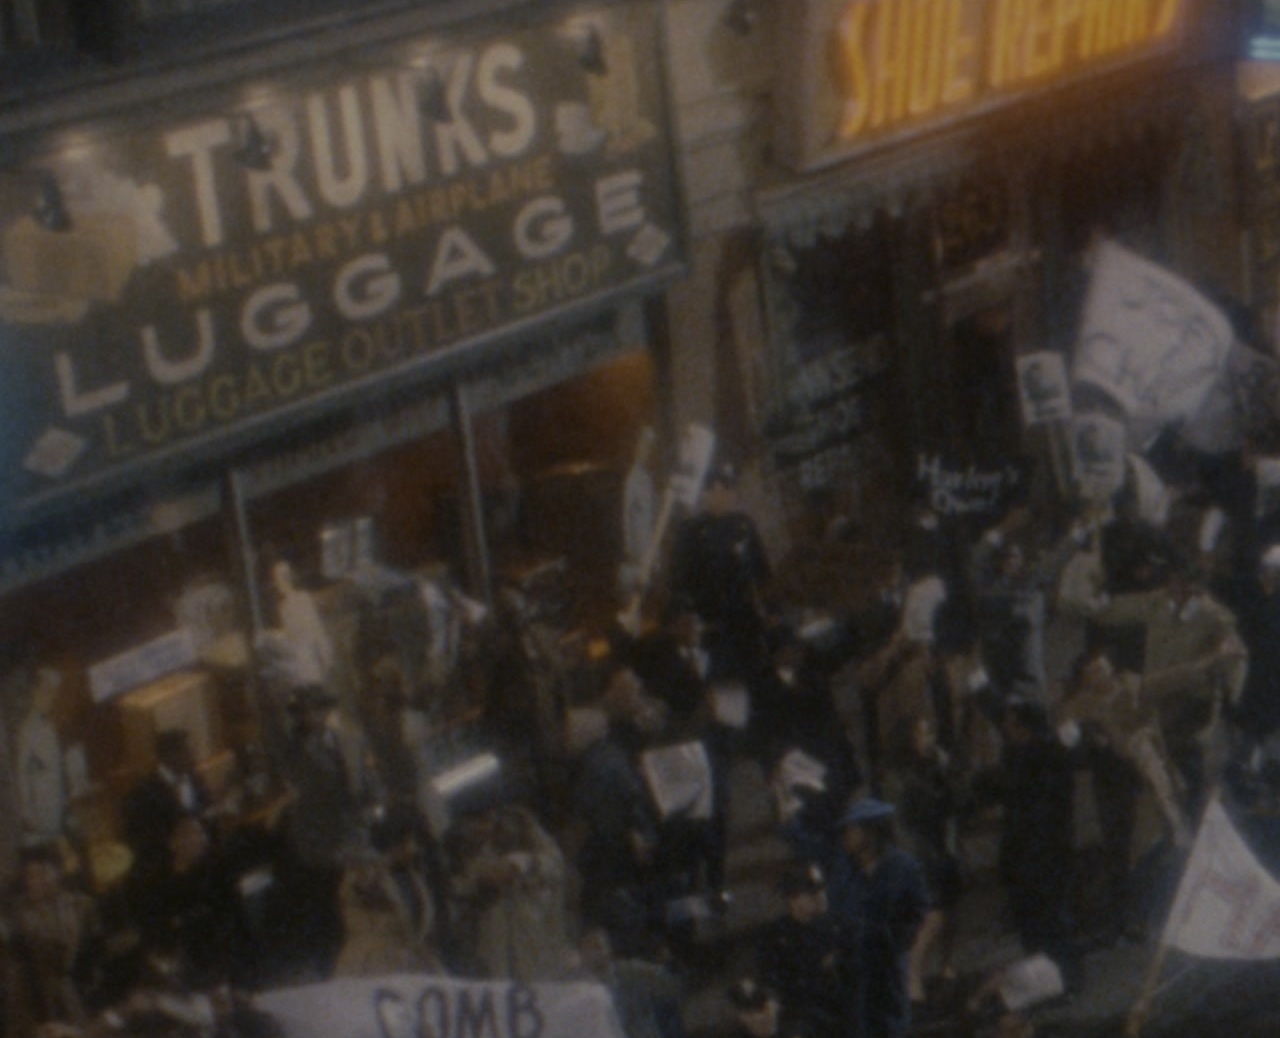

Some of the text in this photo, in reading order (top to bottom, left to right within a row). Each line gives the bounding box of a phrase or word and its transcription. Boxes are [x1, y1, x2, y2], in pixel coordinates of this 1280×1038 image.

[166, 43, 536, 249] TRUNKS
[54, 170, 646, 417] LUGGAGE
[103, 342, 334, 456] LUGGAGE
[511, 243, 613, 312] SHOP
[176, 224, 357, 301] MILITARY
